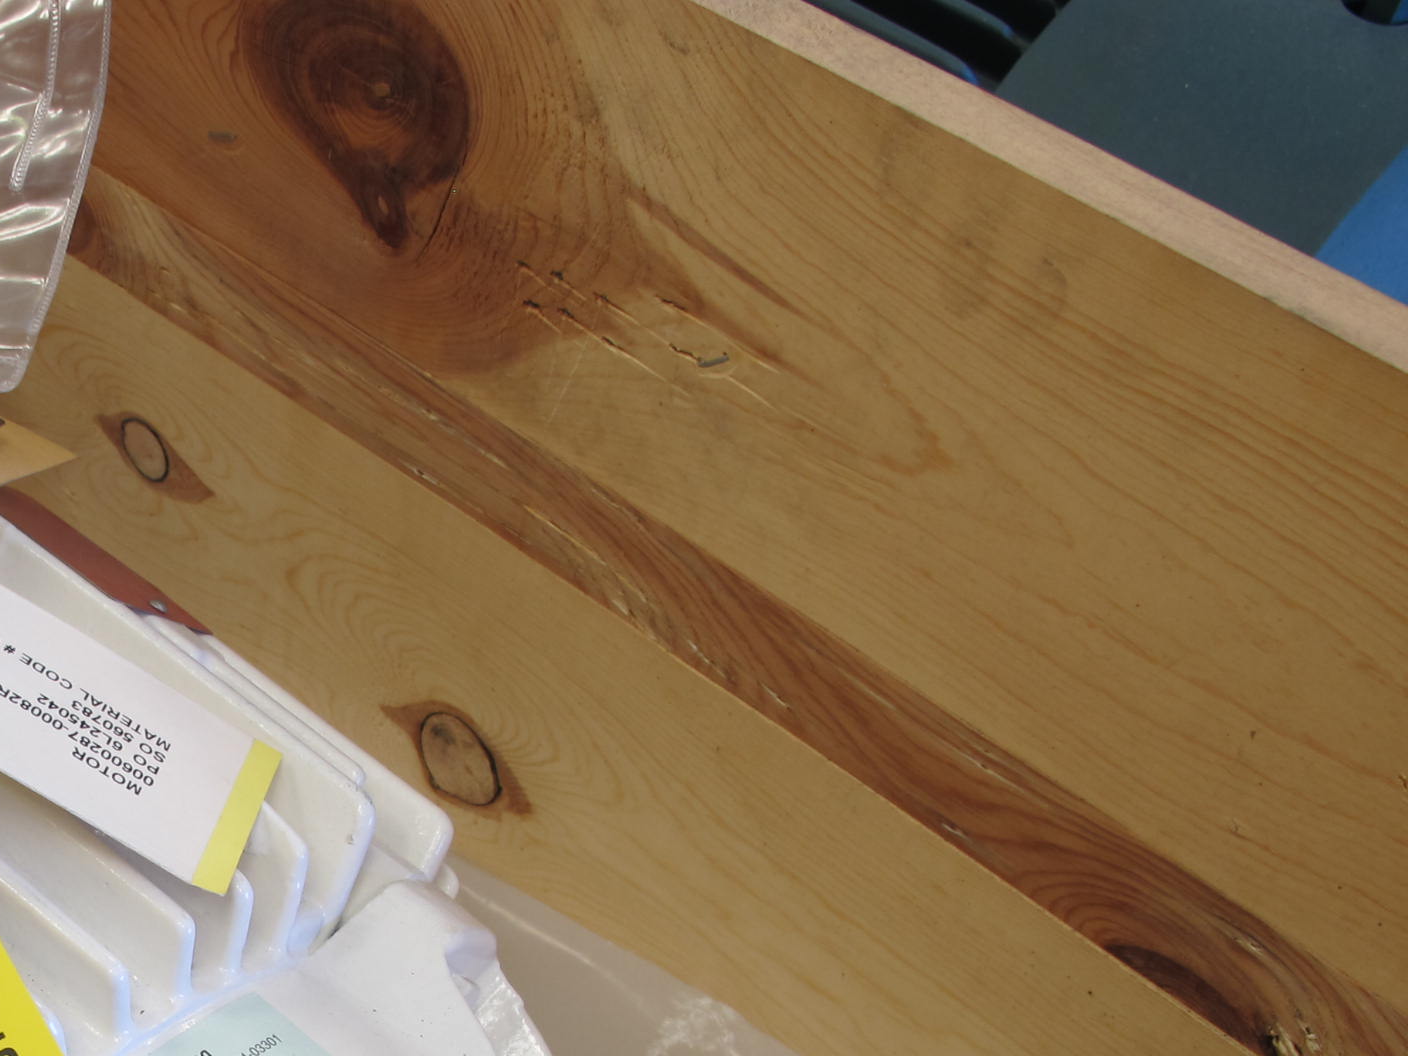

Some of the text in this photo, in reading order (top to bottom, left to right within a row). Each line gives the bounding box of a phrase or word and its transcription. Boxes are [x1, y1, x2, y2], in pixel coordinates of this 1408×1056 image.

[3, 644, 16, 654] #
[18, 652, 73, 690] CODE
[36, 693, 160, 776] PO 6L245042
[71, 699, 166, 764] SO 560783
[79, 688, 171, 751] MATERIAL
[71, 746, 142, 796] MOTOR
